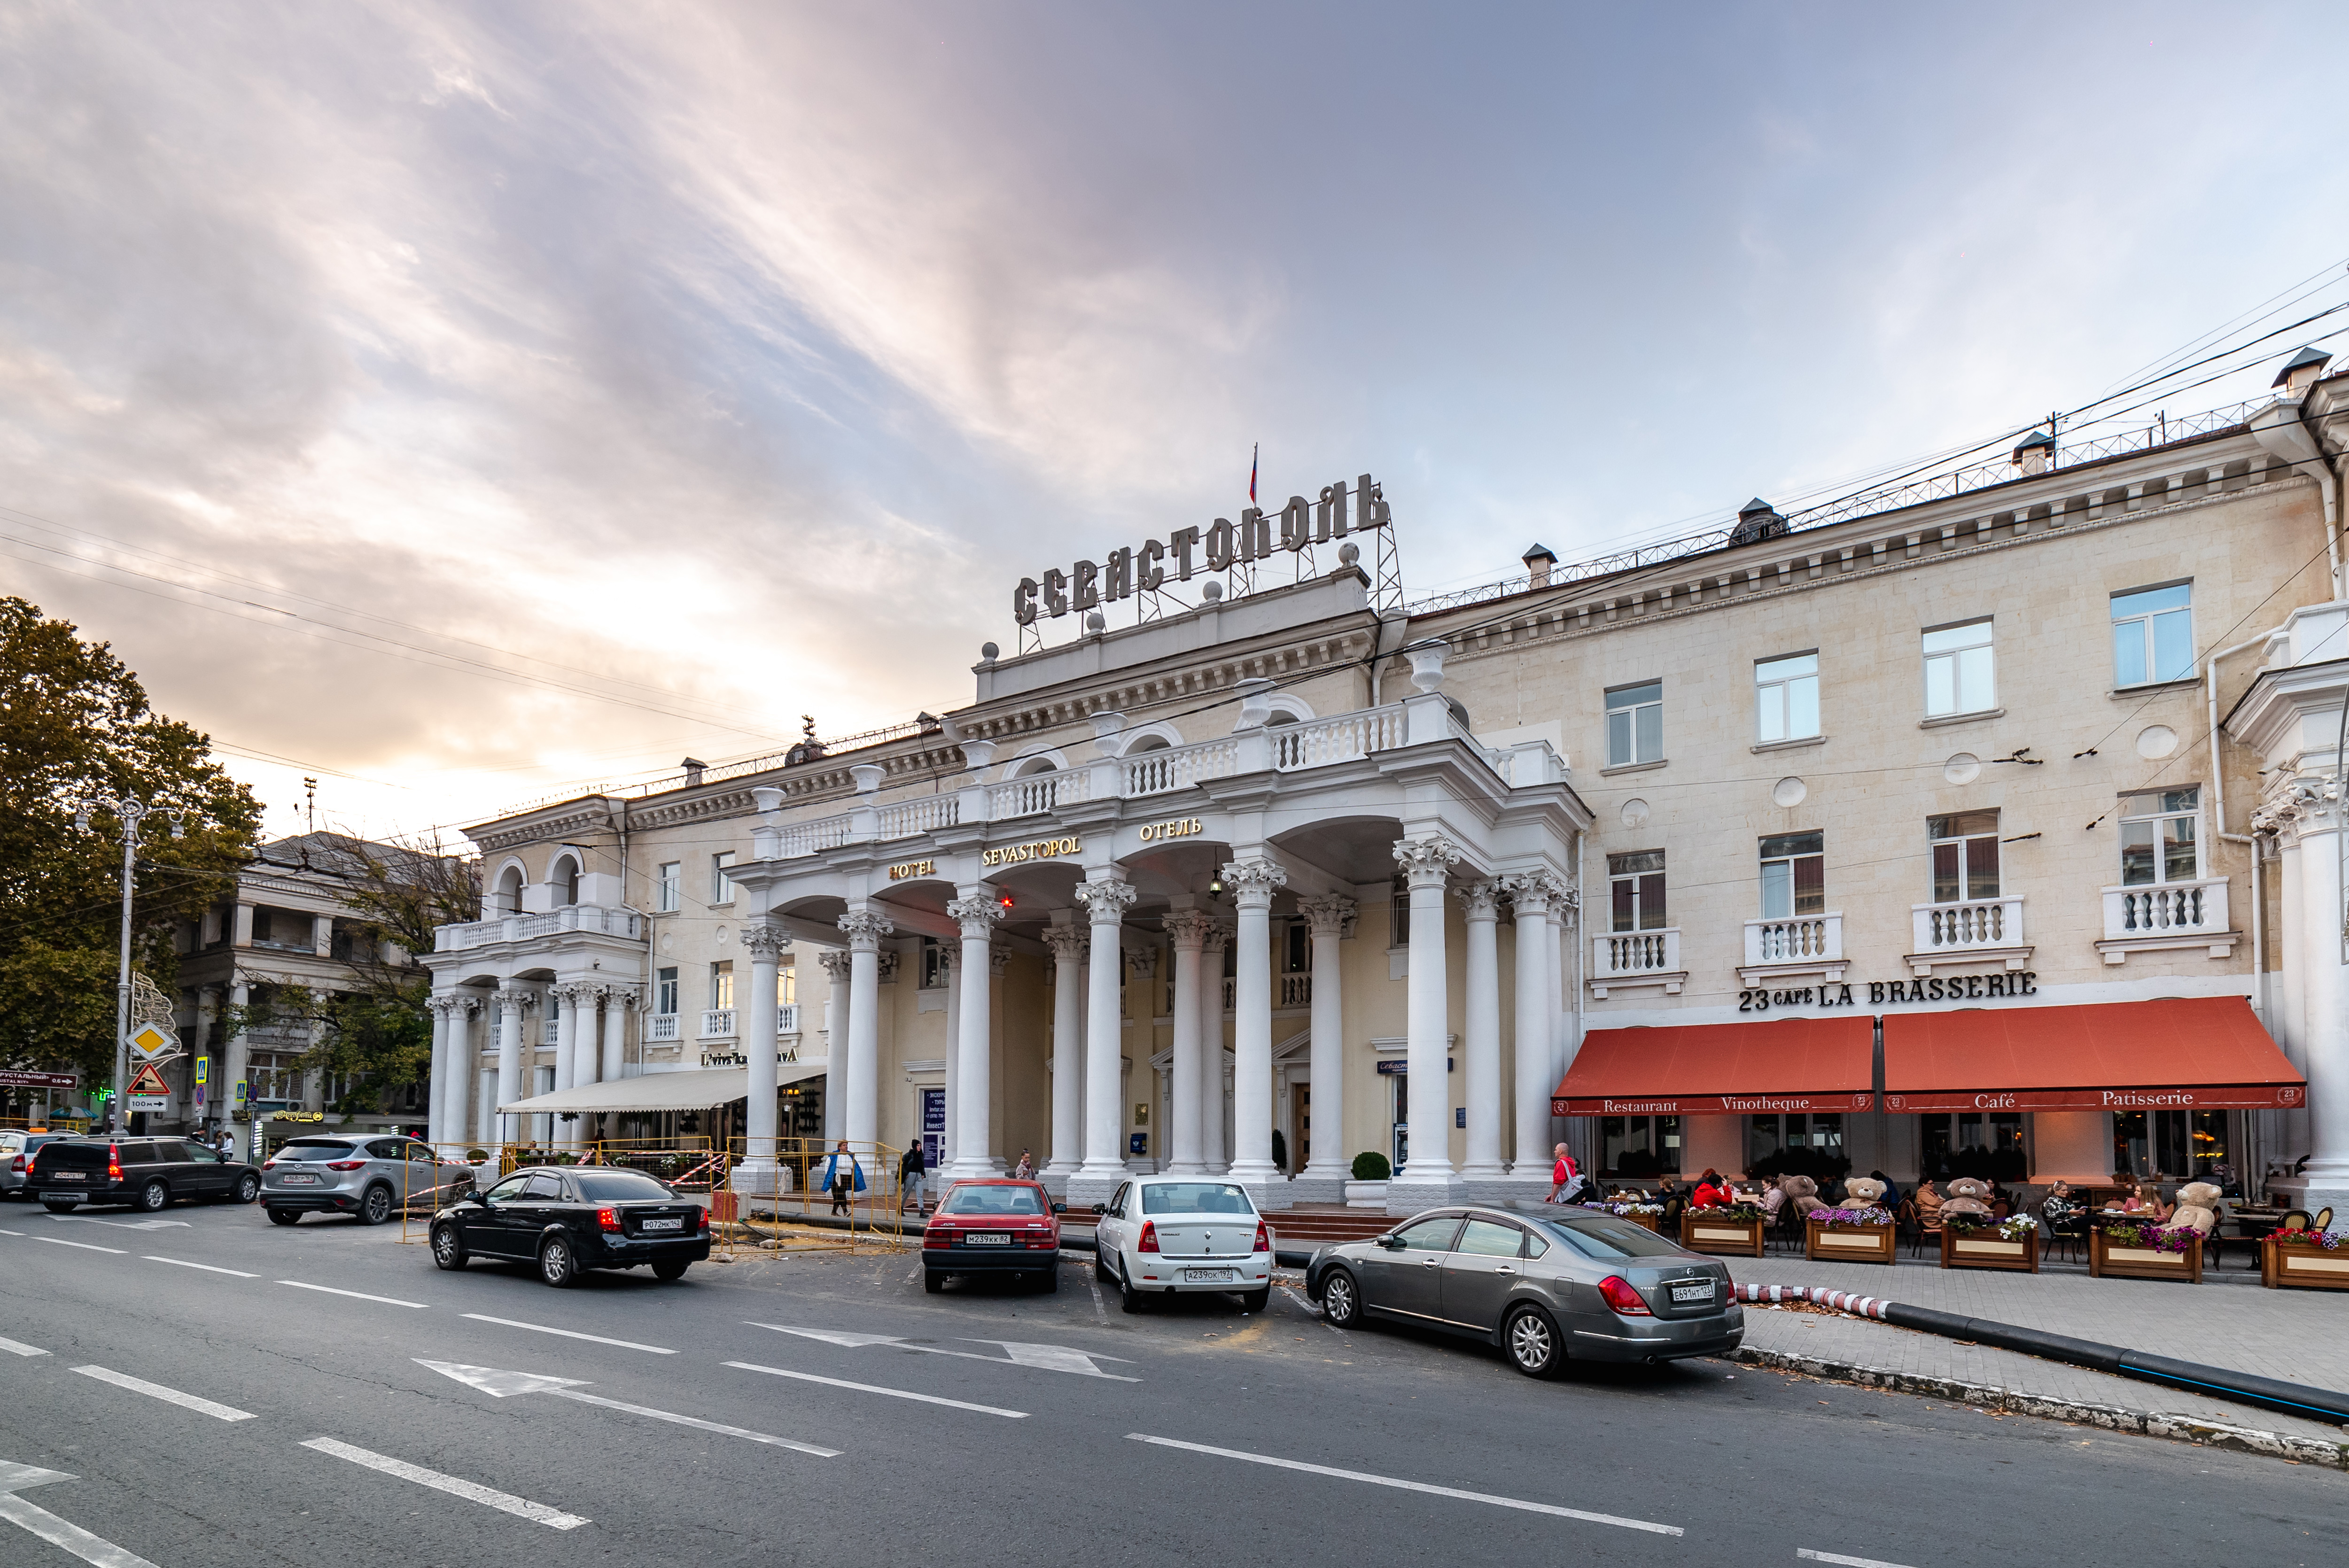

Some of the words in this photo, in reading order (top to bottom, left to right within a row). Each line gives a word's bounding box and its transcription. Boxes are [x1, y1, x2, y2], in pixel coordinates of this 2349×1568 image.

[1140, 818, 1202, 841] ОТЕЛЬ
[982, 837, 1081, 866] SEVASTOPOL
[888, 859, 936, 879] HOTEL
[1739, 989, 1769, 1011] 23
[1818, 984, 1855, 1006] LA
[1868, 972, 2037, 1003] BRASSERIE
[1603, 1100, 1678, 1112] Restaurant
[1720, 1096, 1809, 1111] Vinotheque
[1975, 1093, 2015, 1108] Café
[2101, 1090, 2193, 1105] Patisserie
[1674, 1289, 1700, 1300] Е691НТ
